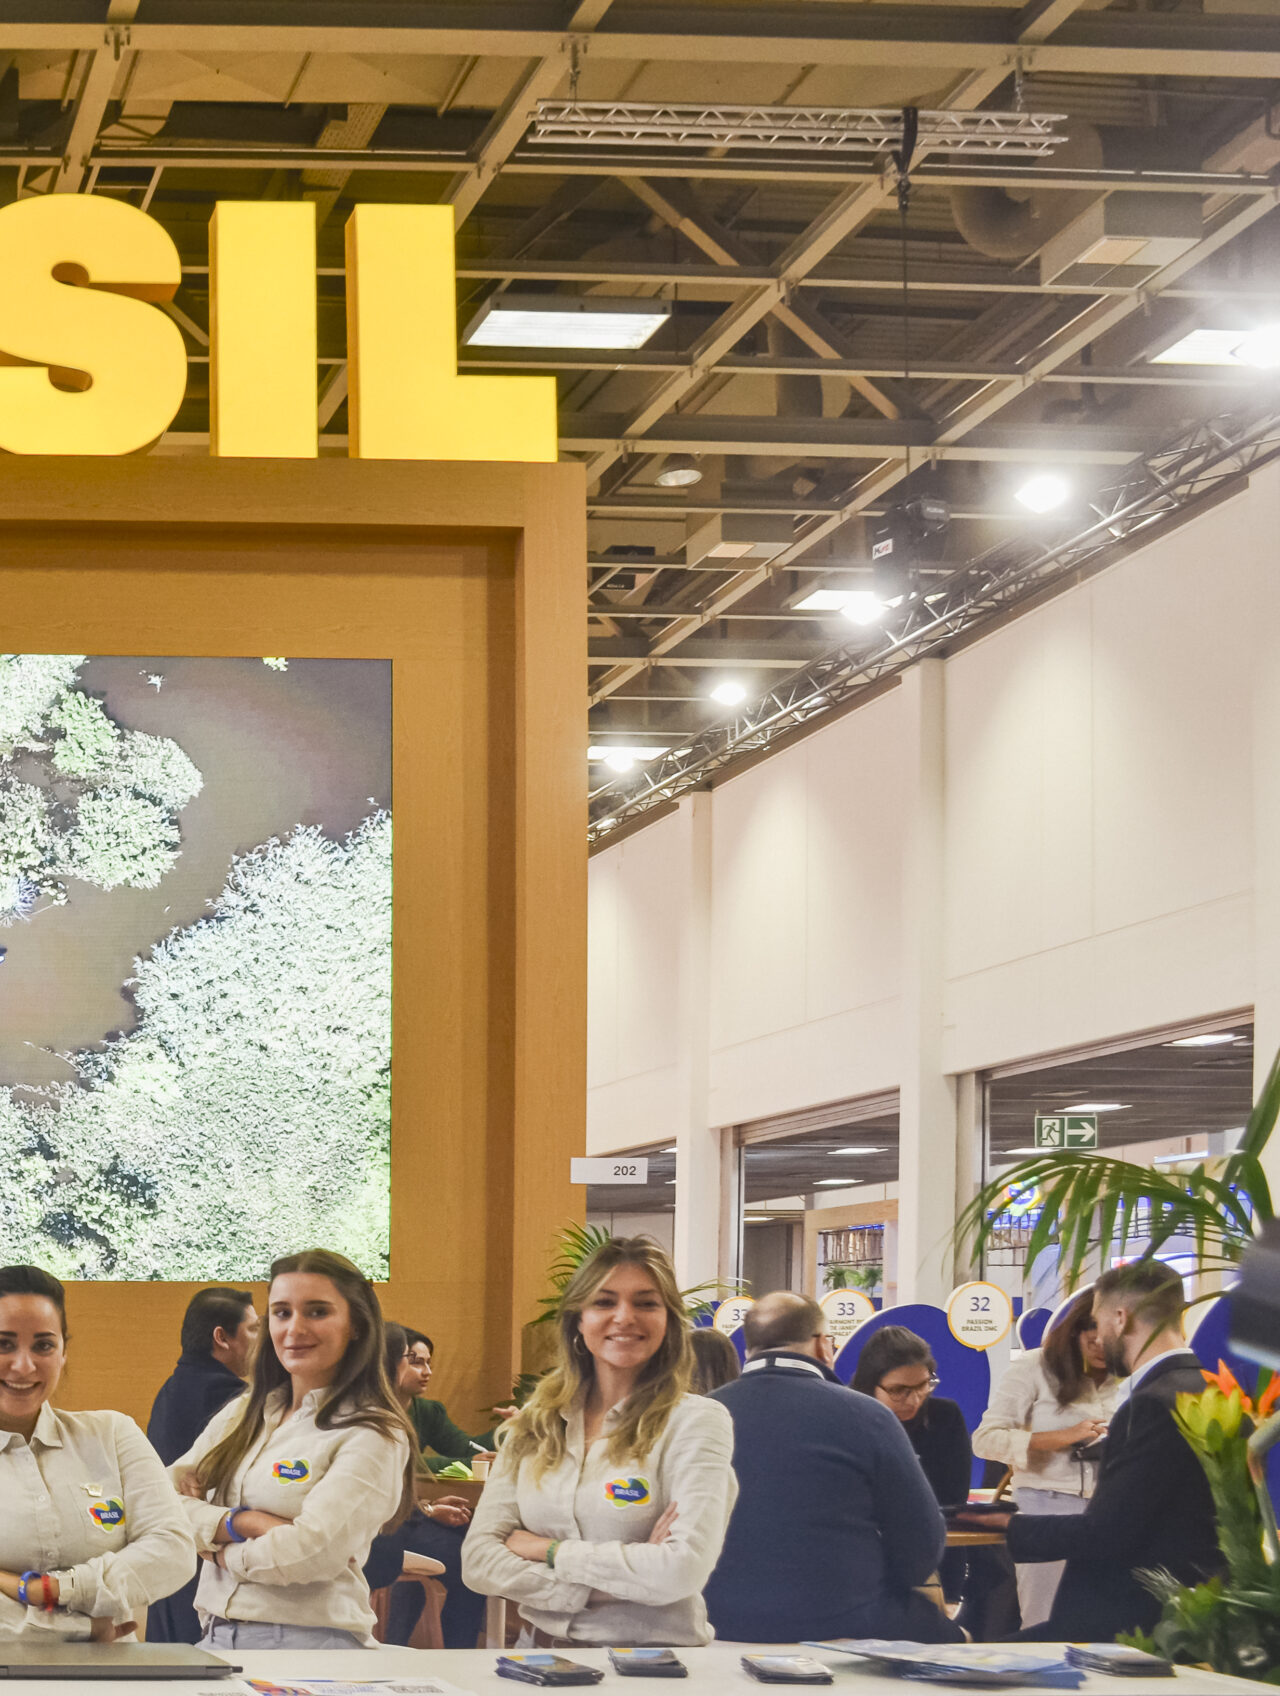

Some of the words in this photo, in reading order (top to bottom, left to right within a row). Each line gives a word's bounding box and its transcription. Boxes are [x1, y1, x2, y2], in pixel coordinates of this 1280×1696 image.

[613, 1165, 637, 1176] 202
[836, 1302, 856, 1316] 33
[970, 1296, 990, 1311] 32
[280, 1467, 301, 1476] BRASIL
[100, 1511, 120, 1519] BRASIL
